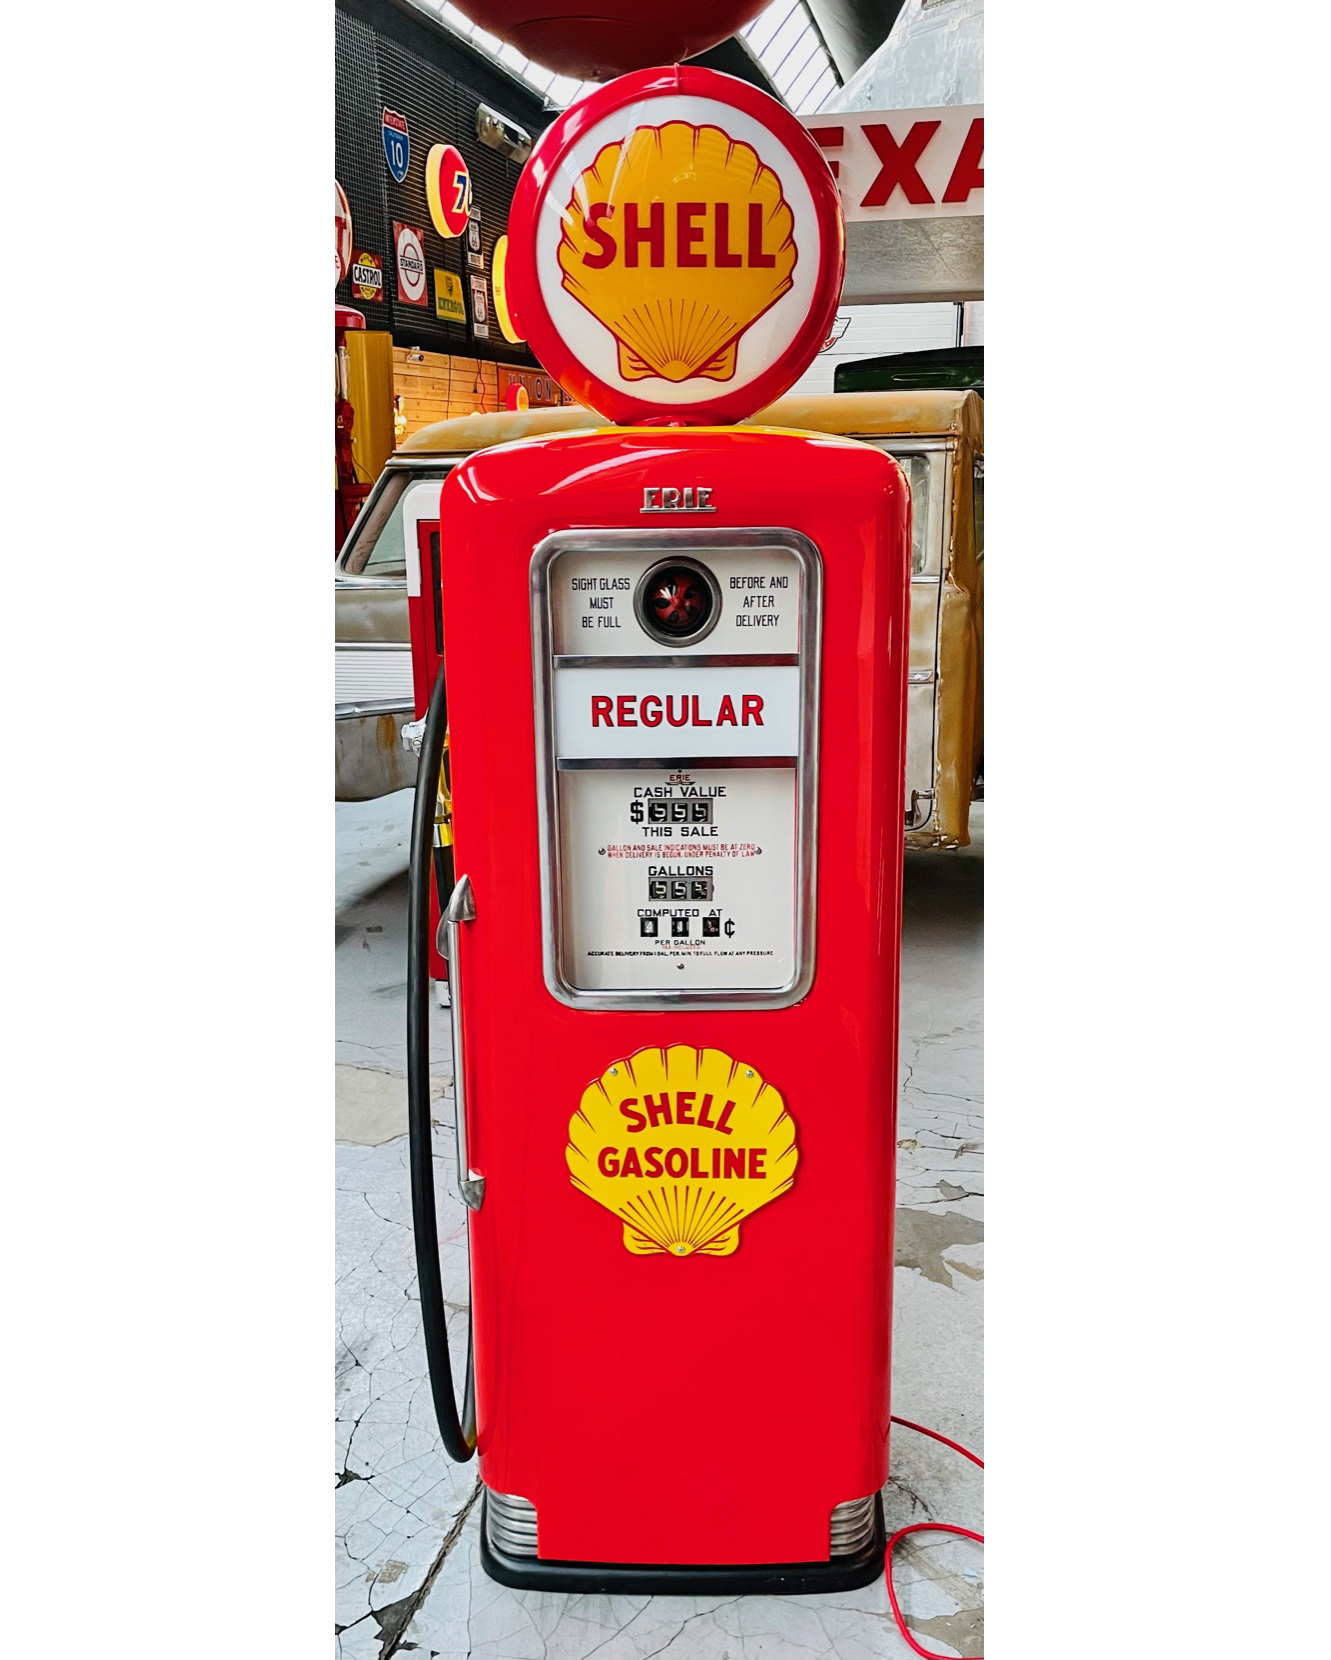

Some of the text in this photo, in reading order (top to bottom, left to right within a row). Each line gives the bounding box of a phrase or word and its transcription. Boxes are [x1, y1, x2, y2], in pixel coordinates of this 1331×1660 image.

[391, 140, 403, 168] 10
[581, 202, 776, 269] SHELL
[400, 258, 424, 271] STANDARD
[354, 266, 381, 287] CASTROL
[643, 487, 714, 509] ERIE
[571, 577, 631, 591] SIGHT GLASS
[729, 576, 788, 589] BEFORE AND
[589, 597, 614, 609] MUST
[743, 595, 775, 608] AFTER
[582, 616, 621, 628] BE FULL
[736, 615, 780, 627] DELIVERY
[591, 694, 765, 728] REGULAR
[634, 786, 727, 798] CASH VALUE
[642, 826, 719, 837] THIS SALE
[648, 865, 714, 876] GALLONS
[637, 908, 723, 917] COMPUTED AT
[619, 1091, 737, 1136] SHELL
[597, 1146, 767, 1179] GASOLINE
